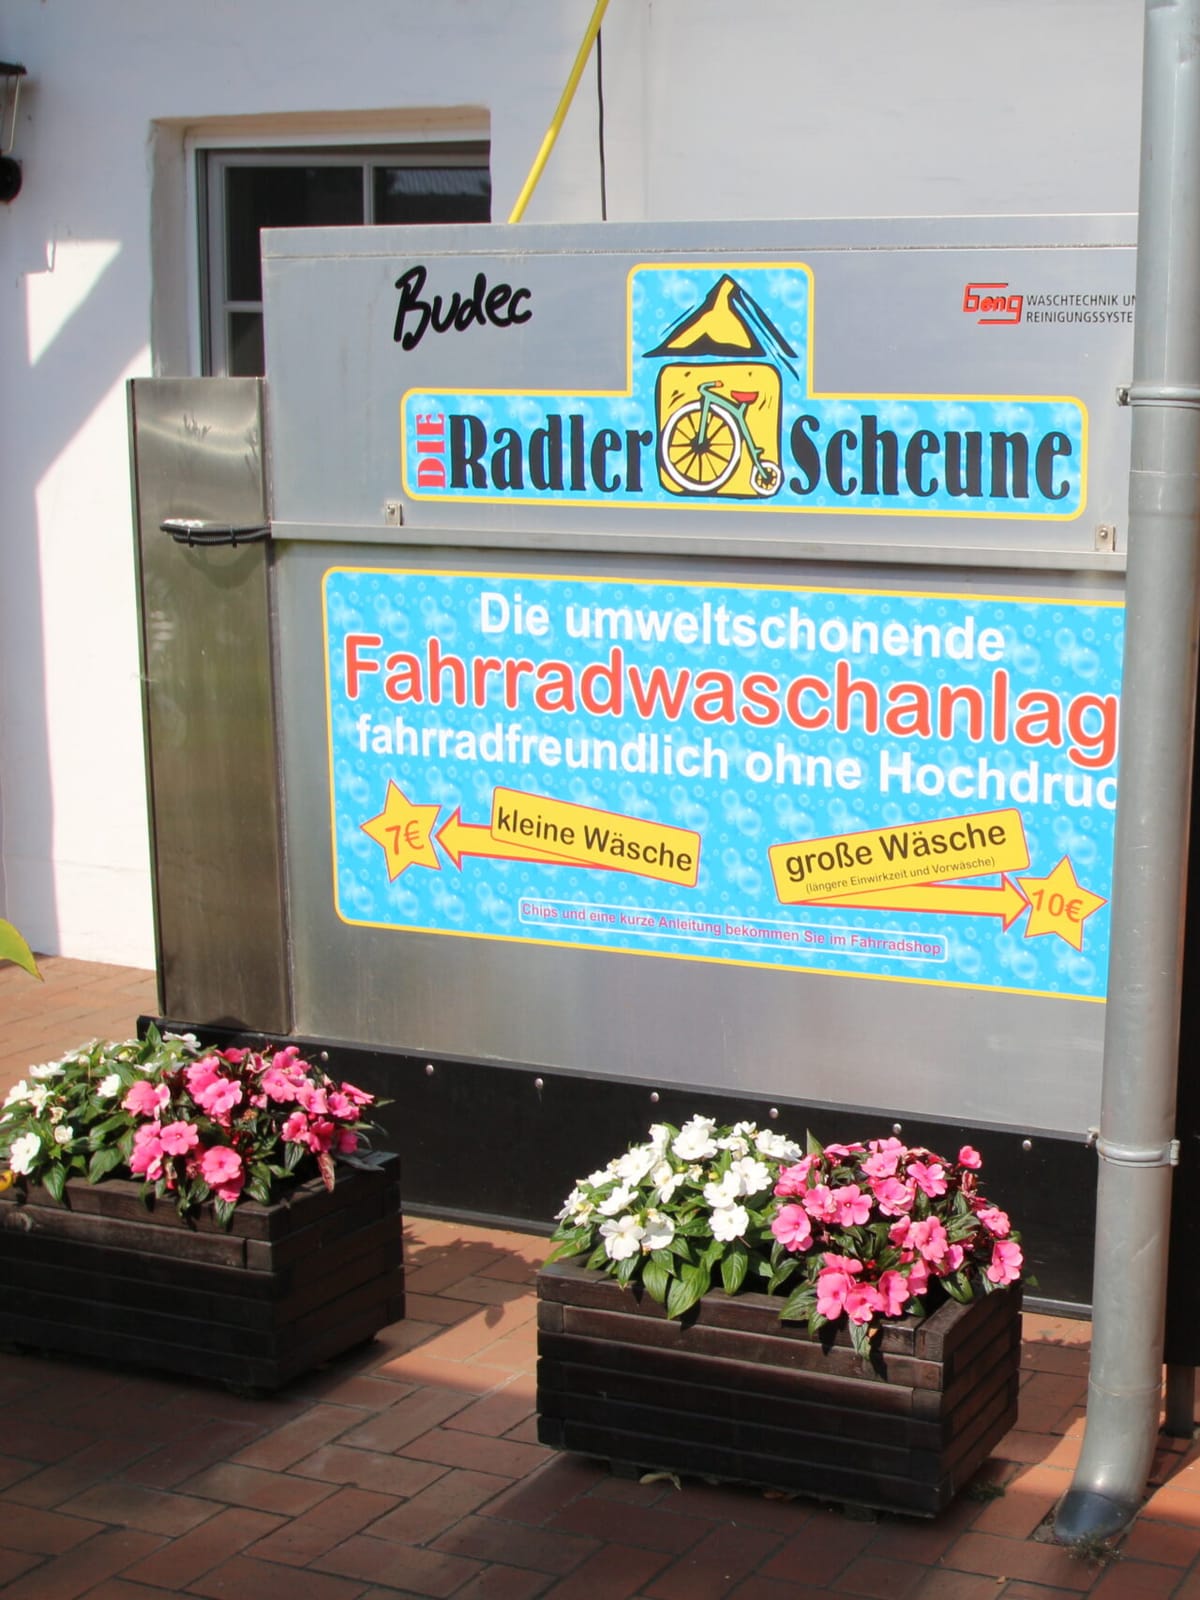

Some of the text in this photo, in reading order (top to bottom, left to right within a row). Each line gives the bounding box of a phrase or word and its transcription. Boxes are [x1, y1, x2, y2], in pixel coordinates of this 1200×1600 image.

[1026, 294, 1118, 307] WASCHTECHNIK
[1026, 311, 1133, 324] REINIGUNGSSYSTE
[416, 413, 1072, 500] DIE Radler Scheune
[480, 591, 1006, 662] Die umweltschonende
[344, 634, 1119, 768] Fahrradwaschanlag
[356, 713, 1117, 811] fahrradfreundlich ohne Hochdruc
[385, 820, 424, 856] 7€
[497, 806, 692, 872] kleine Wäsche
[786, 822, 1006, 883] große Wäsche
[805, 856, 995, 895] (längere Einwirkzeit und Vorwäsche)
[522, 903, 942, 955] Chips und eine kurze Anleitung bekommen Sie im Fahrradshop
[1032, 888, 1085, 924] 10€
